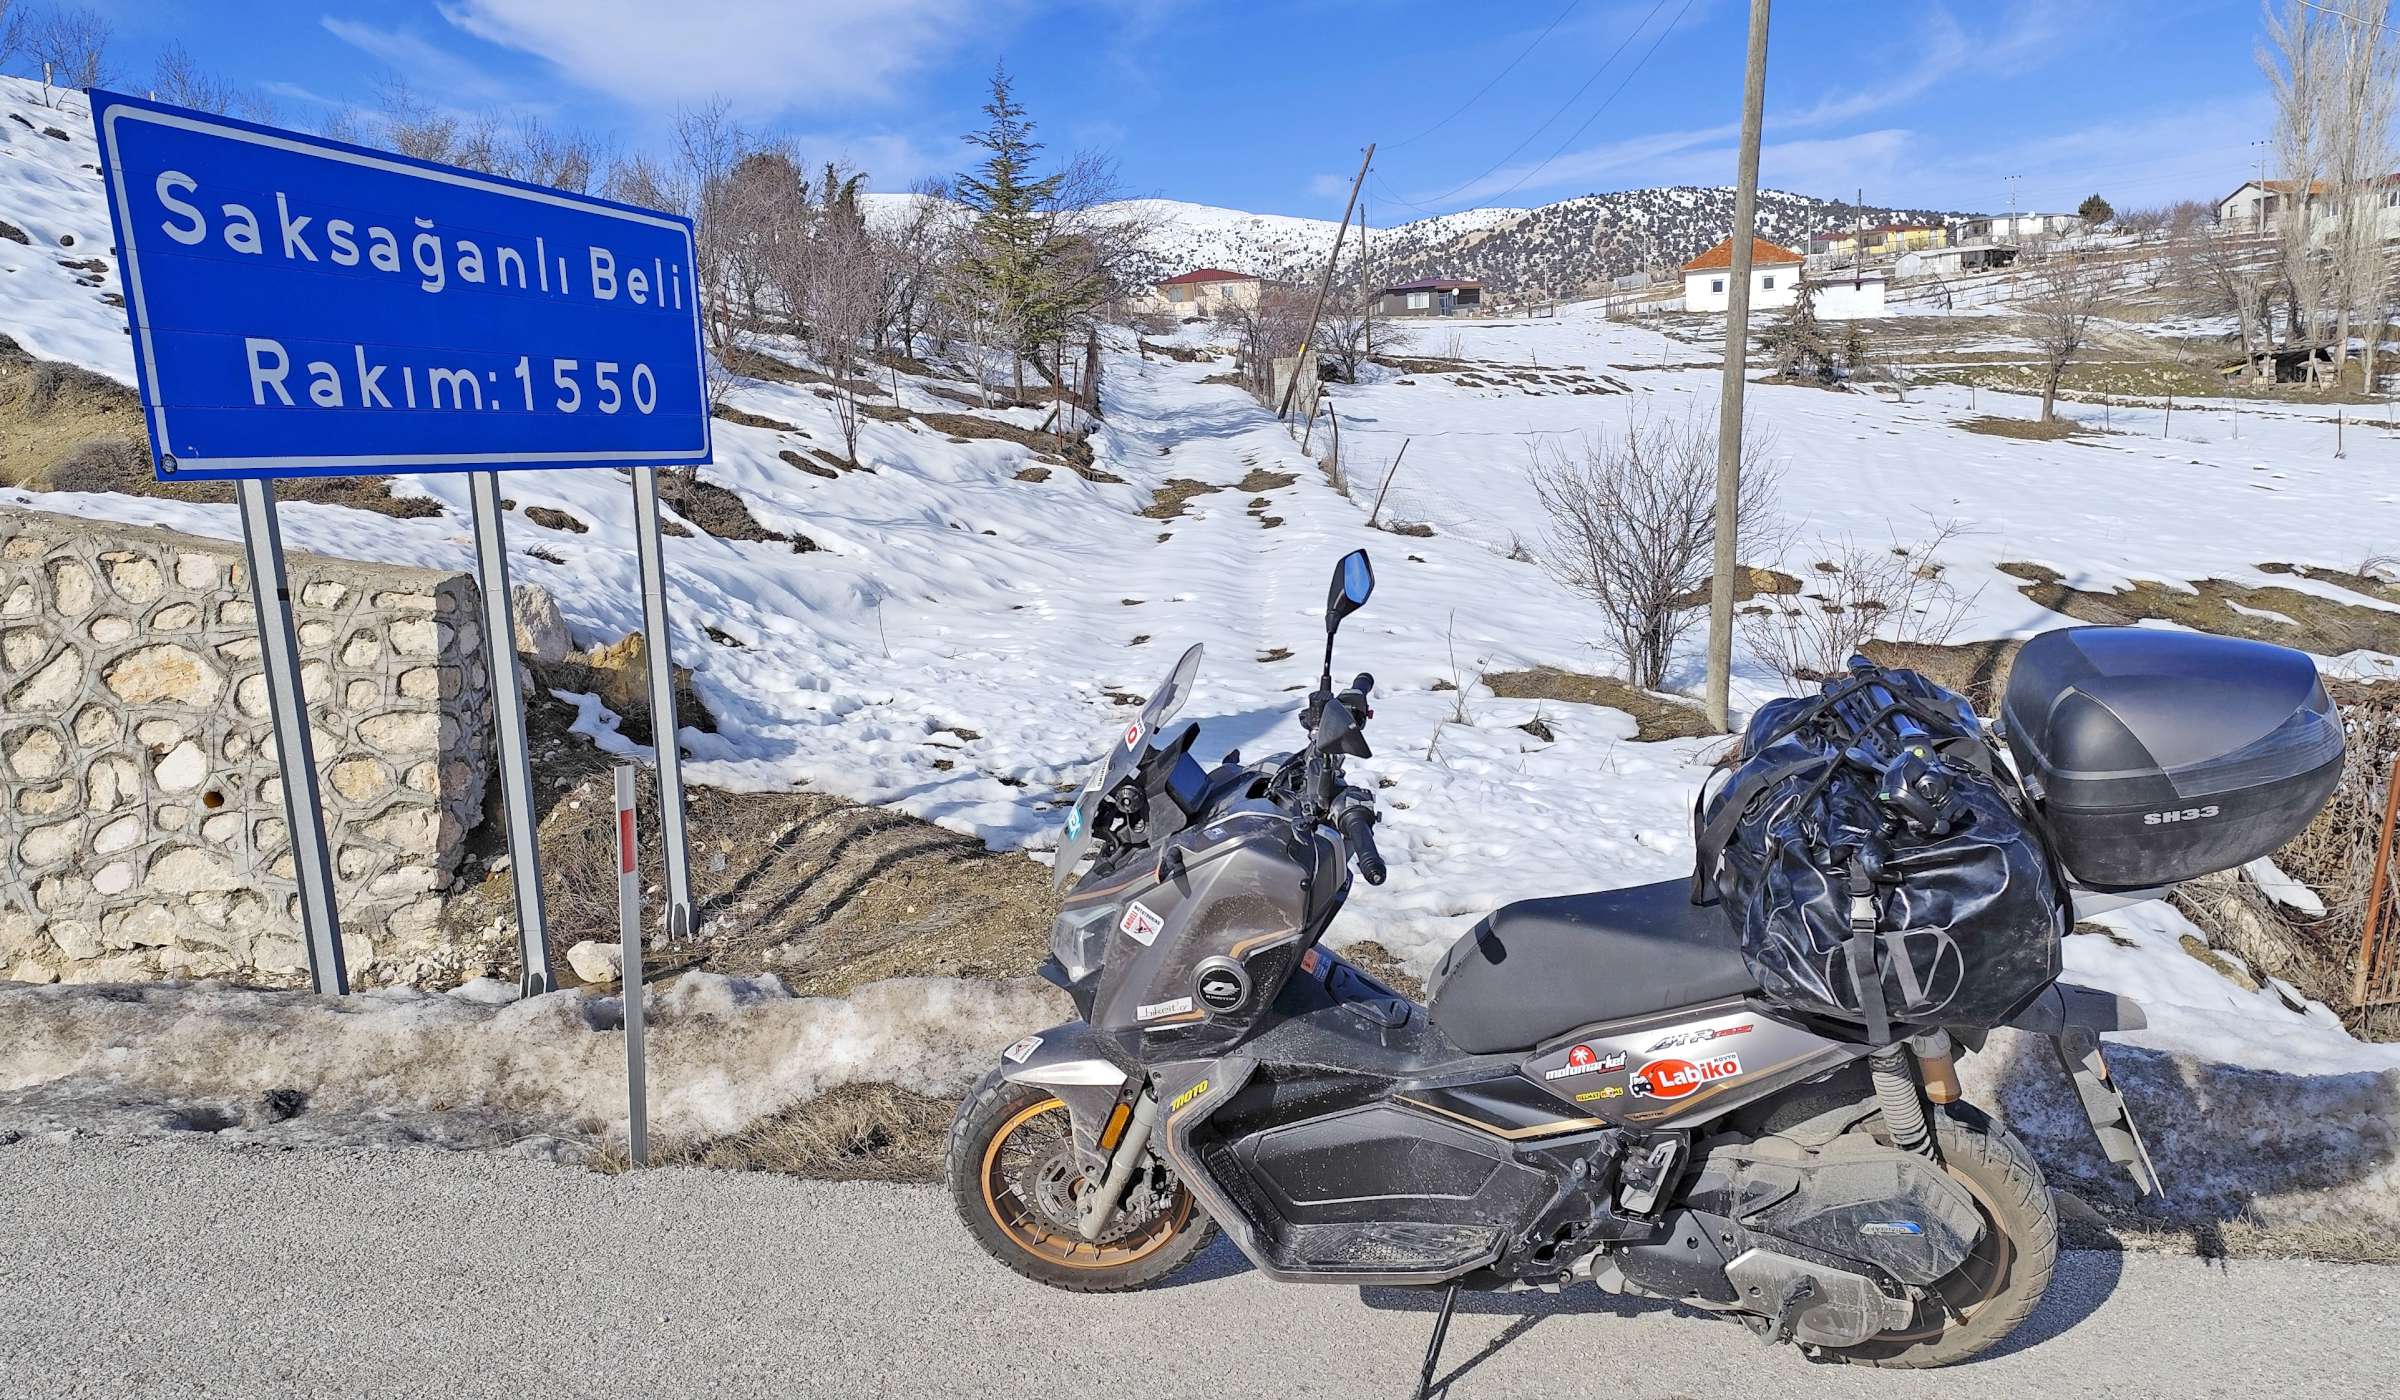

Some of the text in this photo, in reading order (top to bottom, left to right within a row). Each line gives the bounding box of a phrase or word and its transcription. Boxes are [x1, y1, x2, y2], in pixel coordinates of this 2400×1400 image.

[155, 170, 682, 310] Saksağanlı Beli
[2143, 805, 2219, 825] SH33
[1544, 1051, 1627, 1081] motomarket
[1657, 1060, 1738, 1088] Labiko
[1170, 1079, 1209, 1112] MOTO
